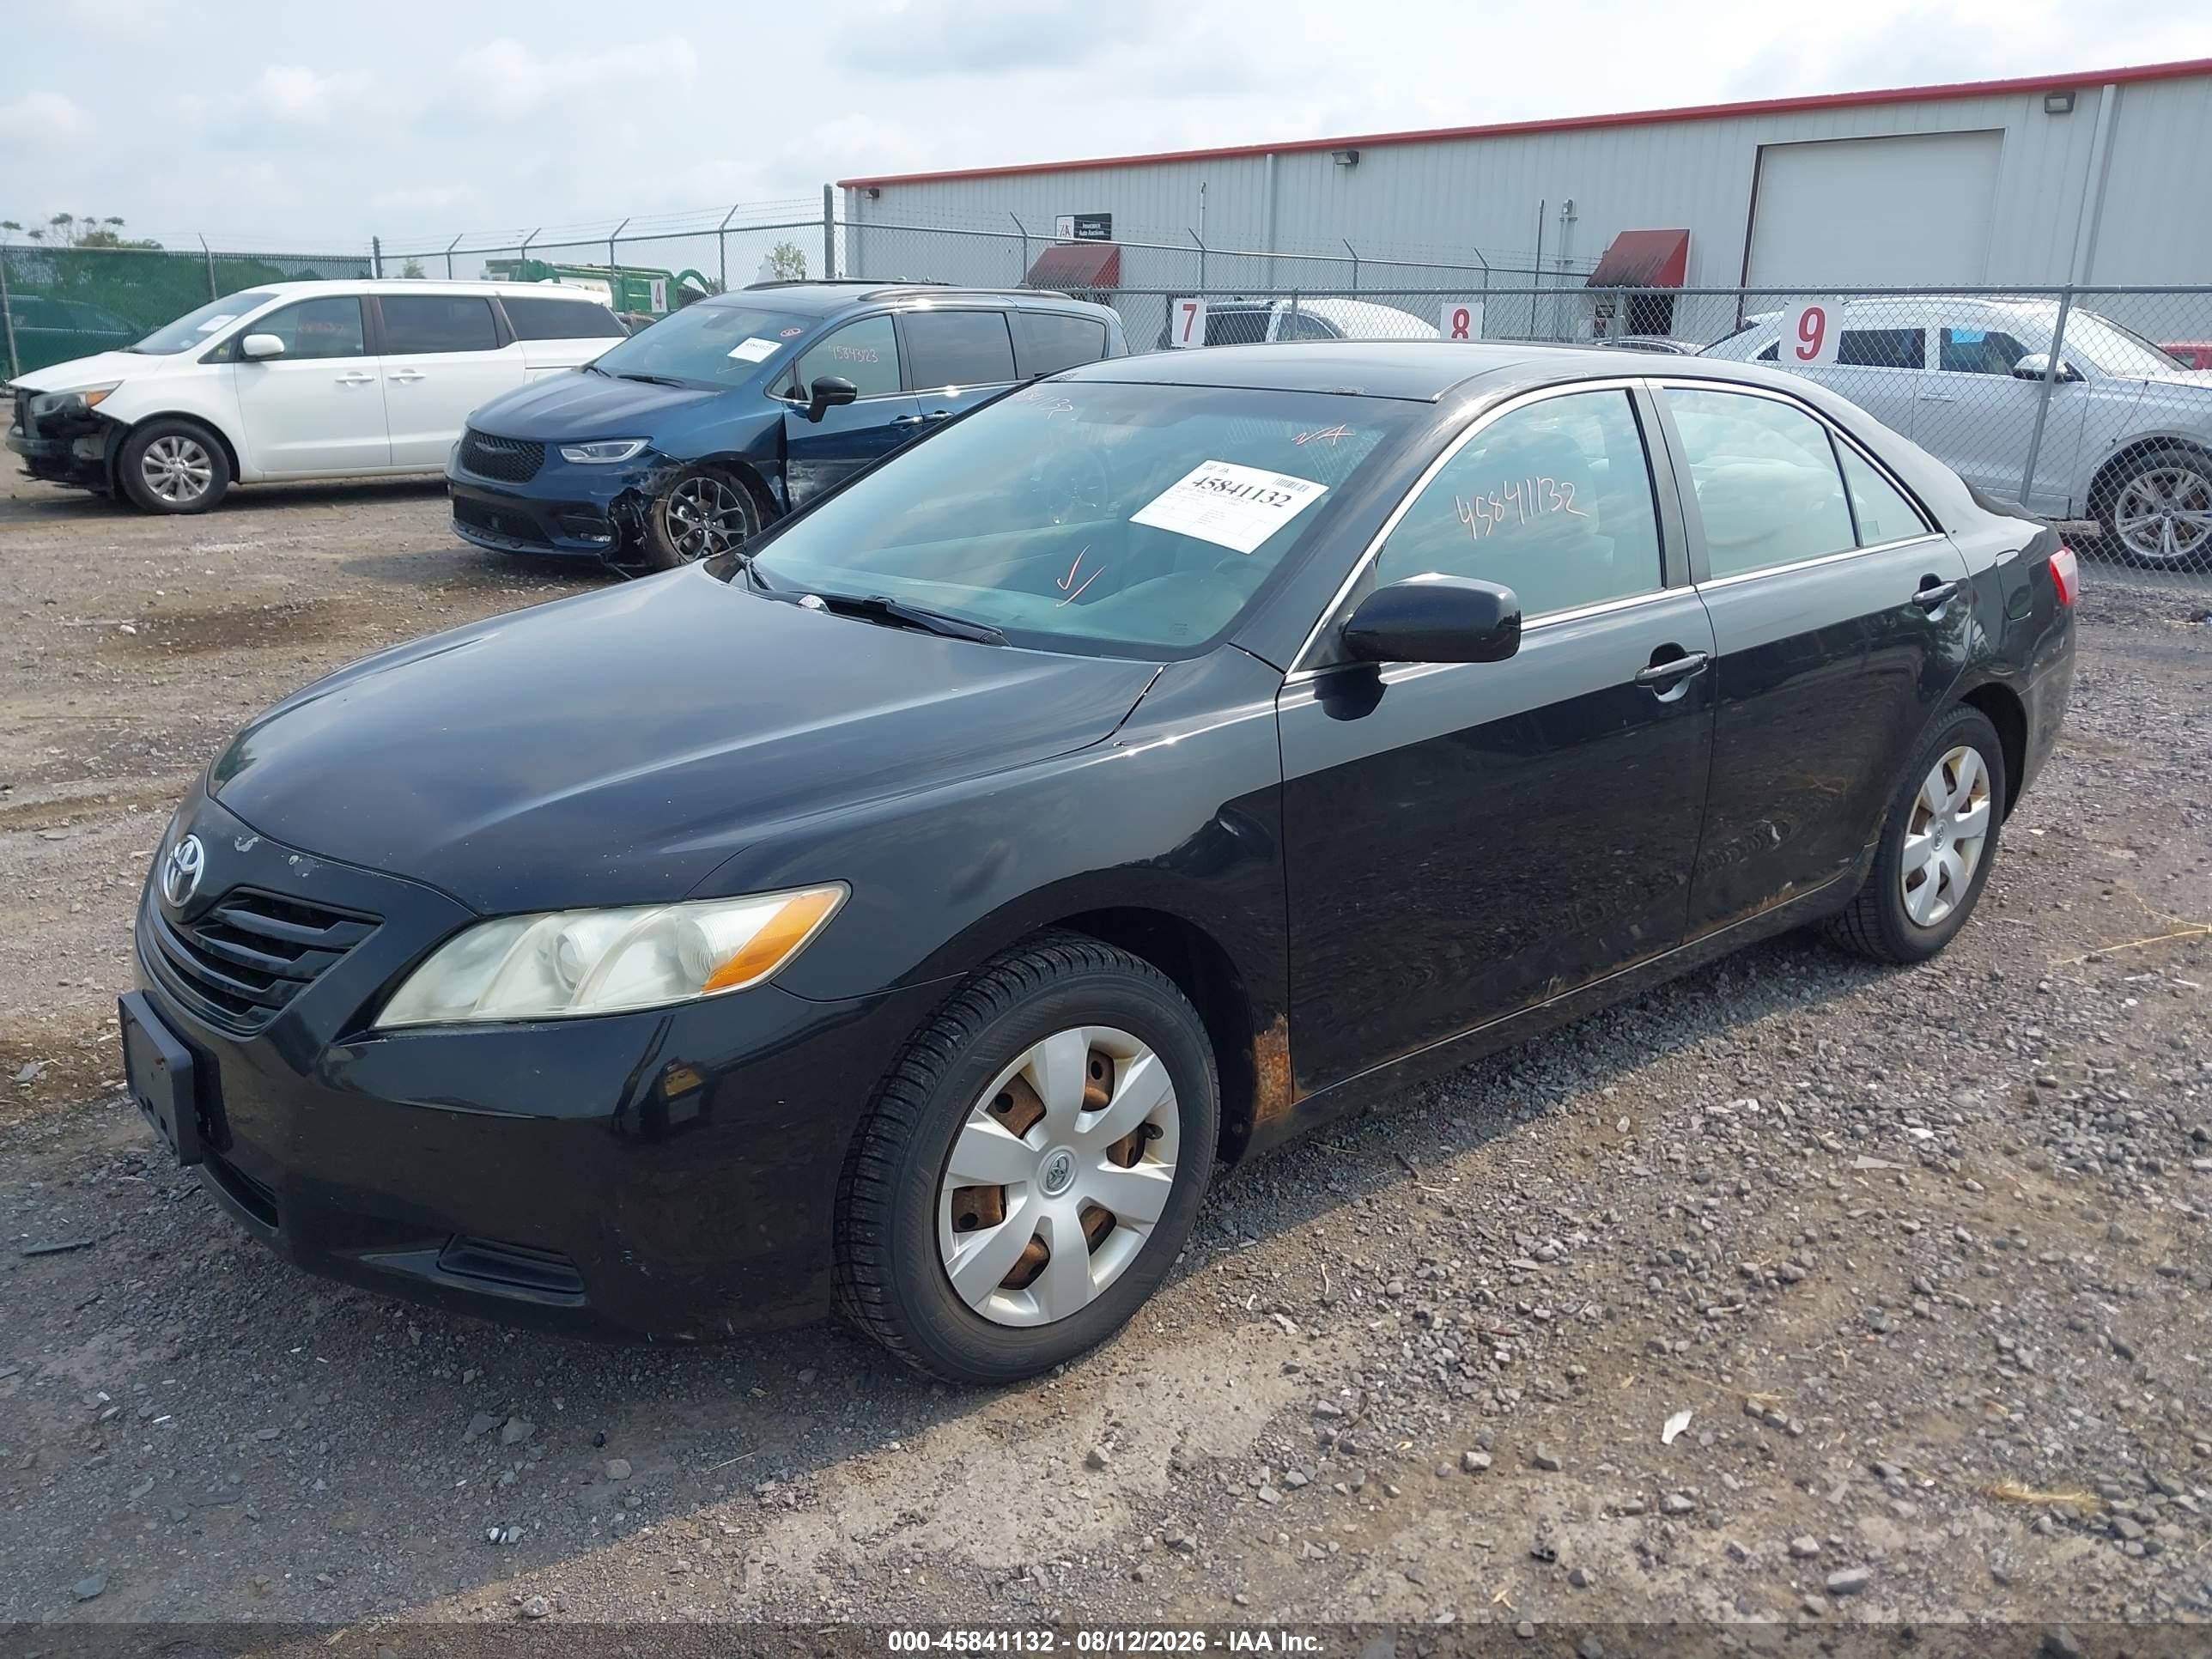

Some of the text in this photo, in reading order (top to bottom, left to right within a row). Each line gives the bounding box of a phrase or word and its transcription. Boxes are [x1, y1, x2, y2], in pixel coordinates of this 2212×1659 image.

[655, 283, 662, 309] 4
[1182, 303, 1197, 342] 7
[1451, 308, 1470, 339] 8
[1796, 307, 1826, 361] 9
[1191, 476, 1292, 507] 45841132
[1455, 476, 1589, 540] 45841132
